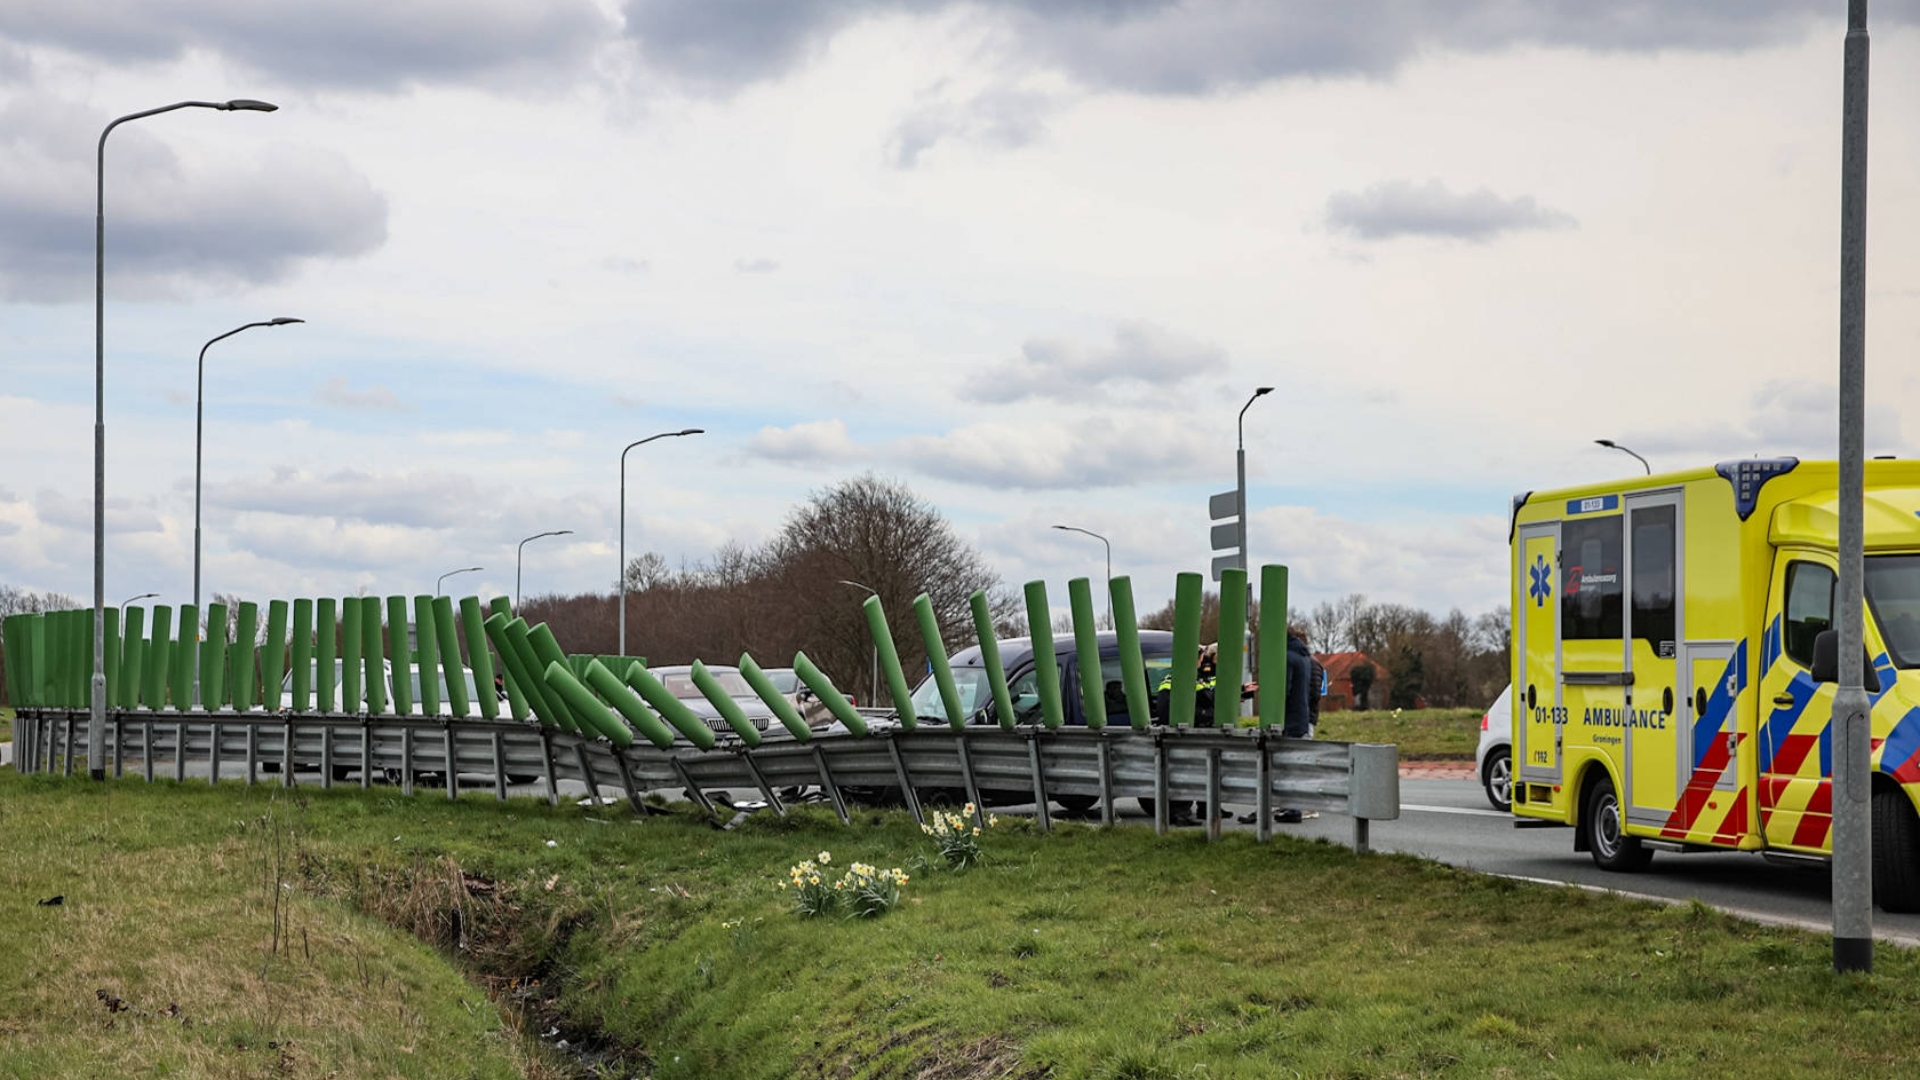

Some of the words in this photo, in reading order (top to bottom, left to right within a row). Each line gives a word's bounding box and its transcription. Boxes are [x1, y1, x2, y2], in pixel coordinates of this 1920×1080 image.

[1535, 706, 1568, 725] 01-133
[1583, 707, 1666, 729] AMBULANCE
[1592, 734, 1622, 746] Groningen
